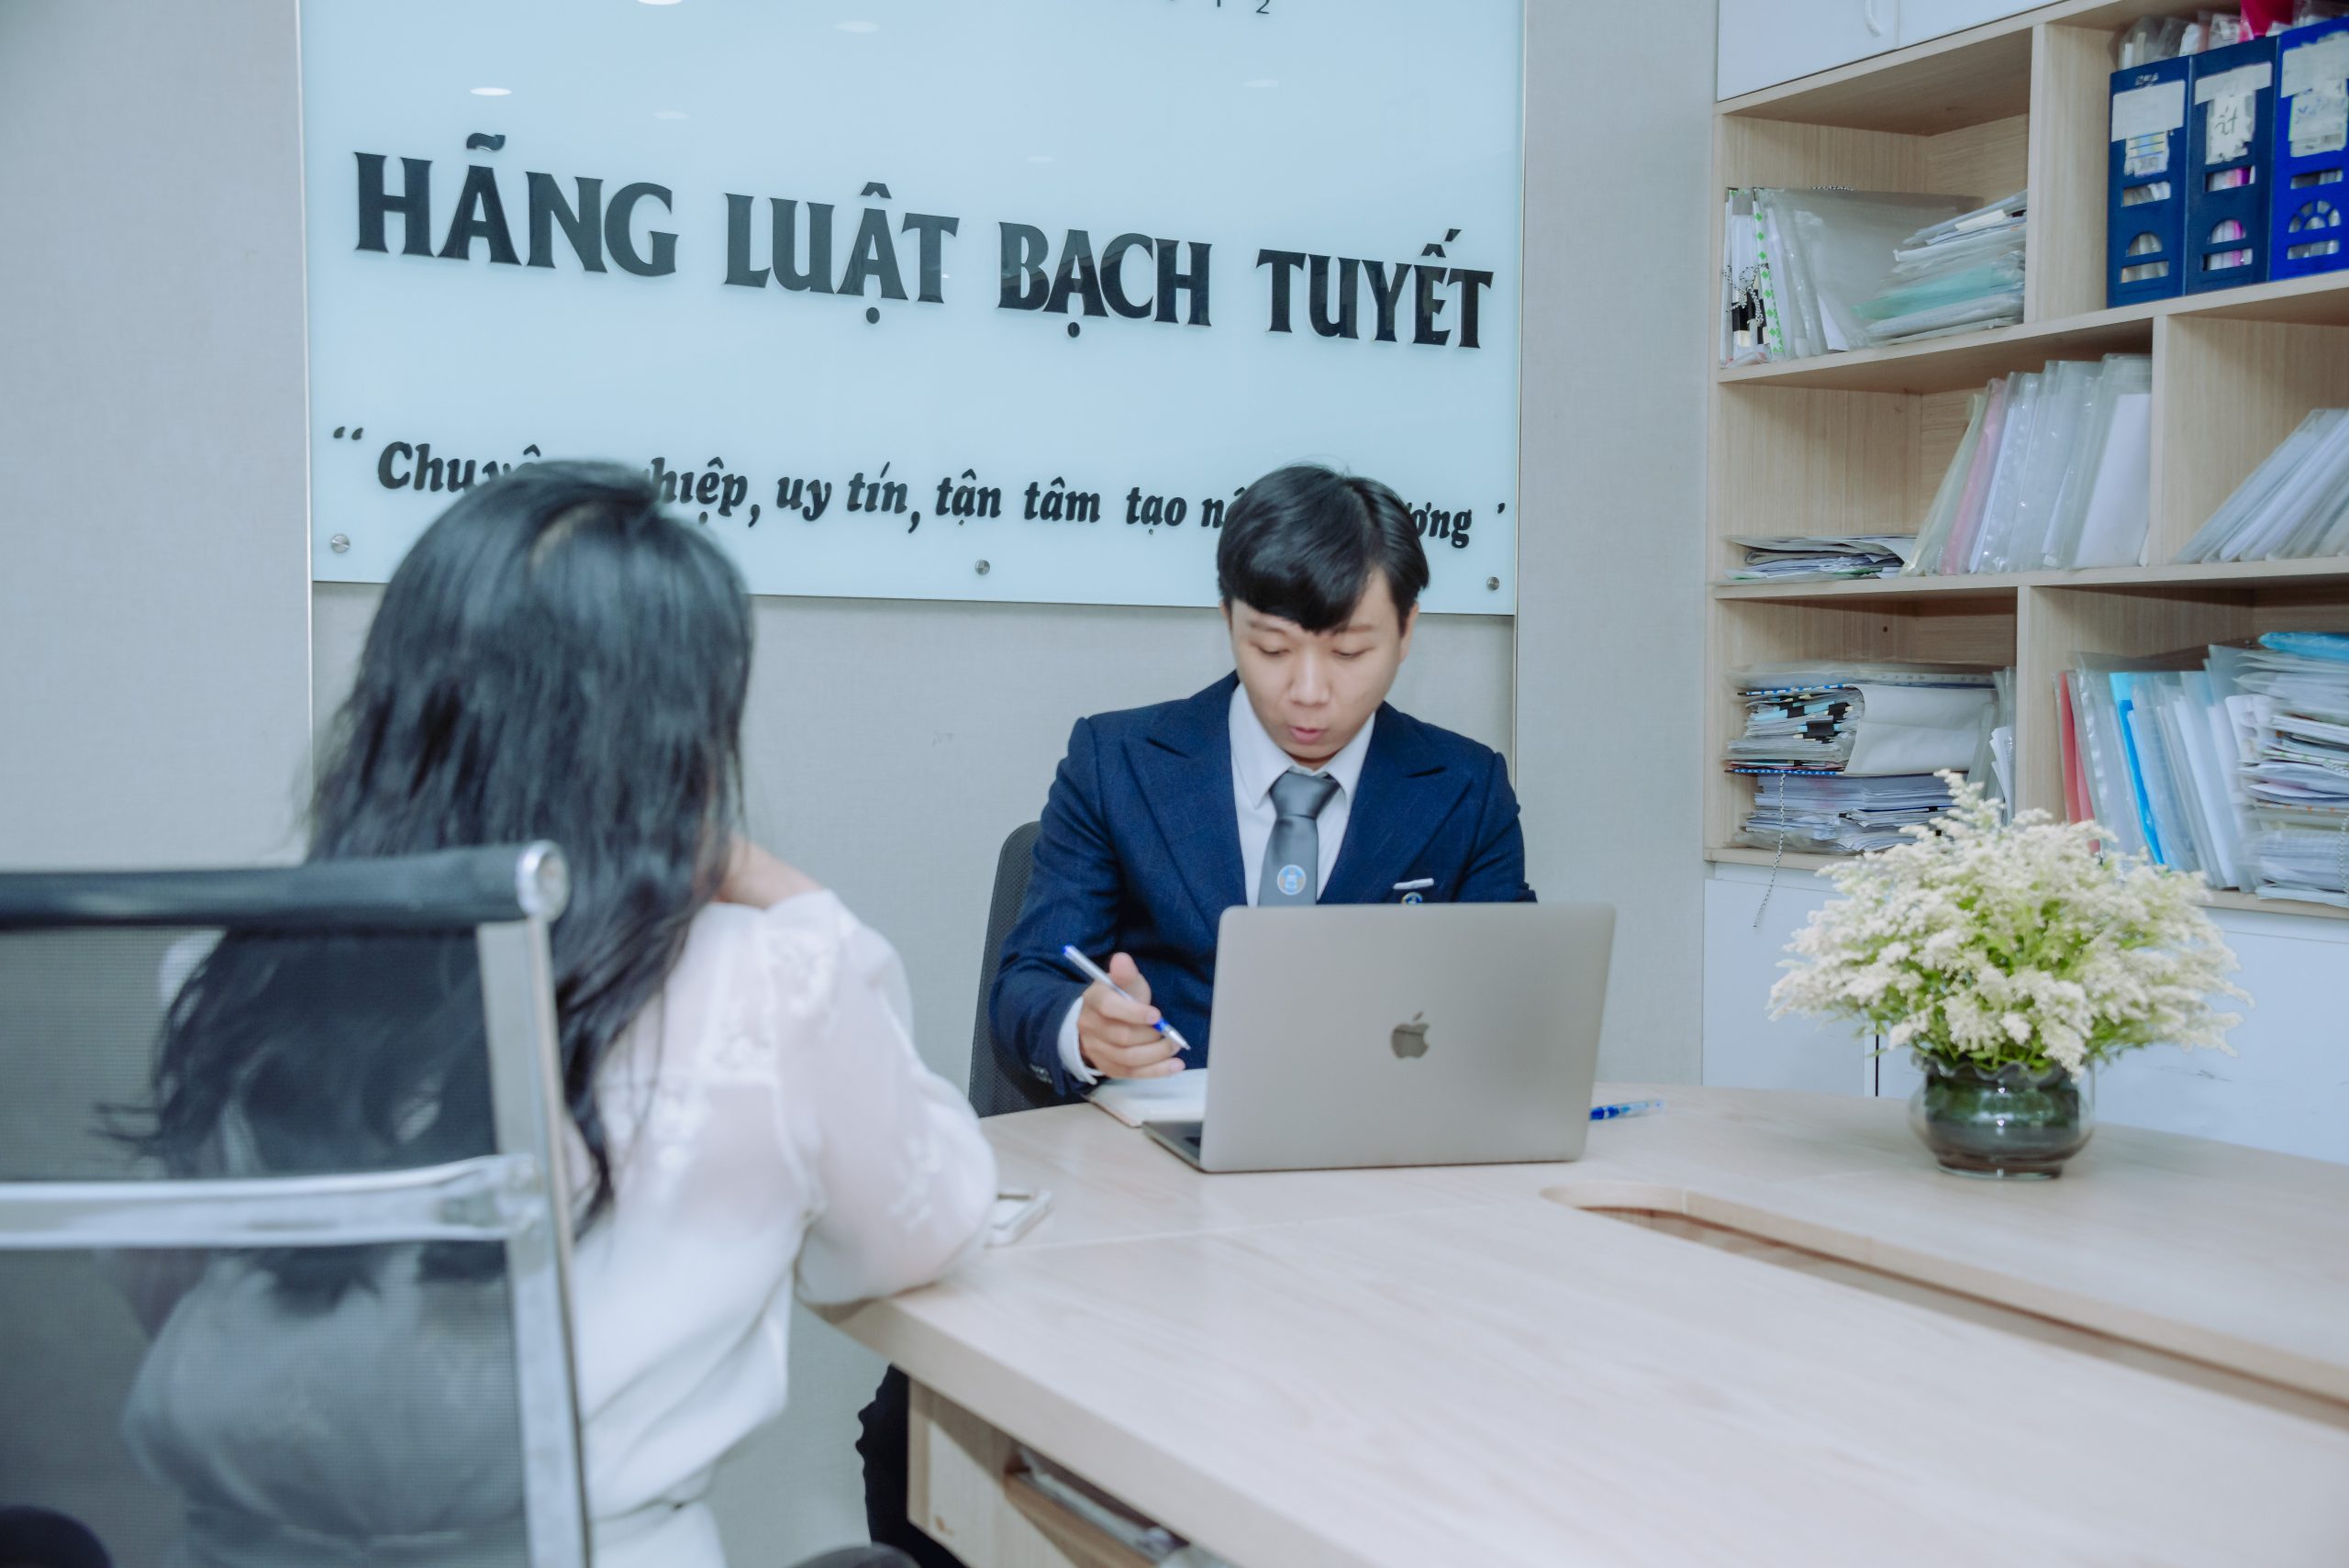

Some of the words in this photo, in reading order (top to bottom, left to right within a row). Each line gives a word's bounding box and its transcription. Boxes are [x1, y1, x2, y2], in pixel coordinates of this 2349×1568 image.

[353, 132, 680, 277] HÃNG
[722, 181, 960, 325] LUẬT
[997, 221, 1213, 339] BẠCH
[1255, 228, 1495, 349] TUYẾT
[642, 456, 761, 528] hiệp,
[776, 476, 832, 522] uy
[846, 461, 921, 534] tín,
[935, 468, 1002, 526] tận
[1024, 476, 1101, 523] tâm
[1126, 486, 1188, 536] tạo
